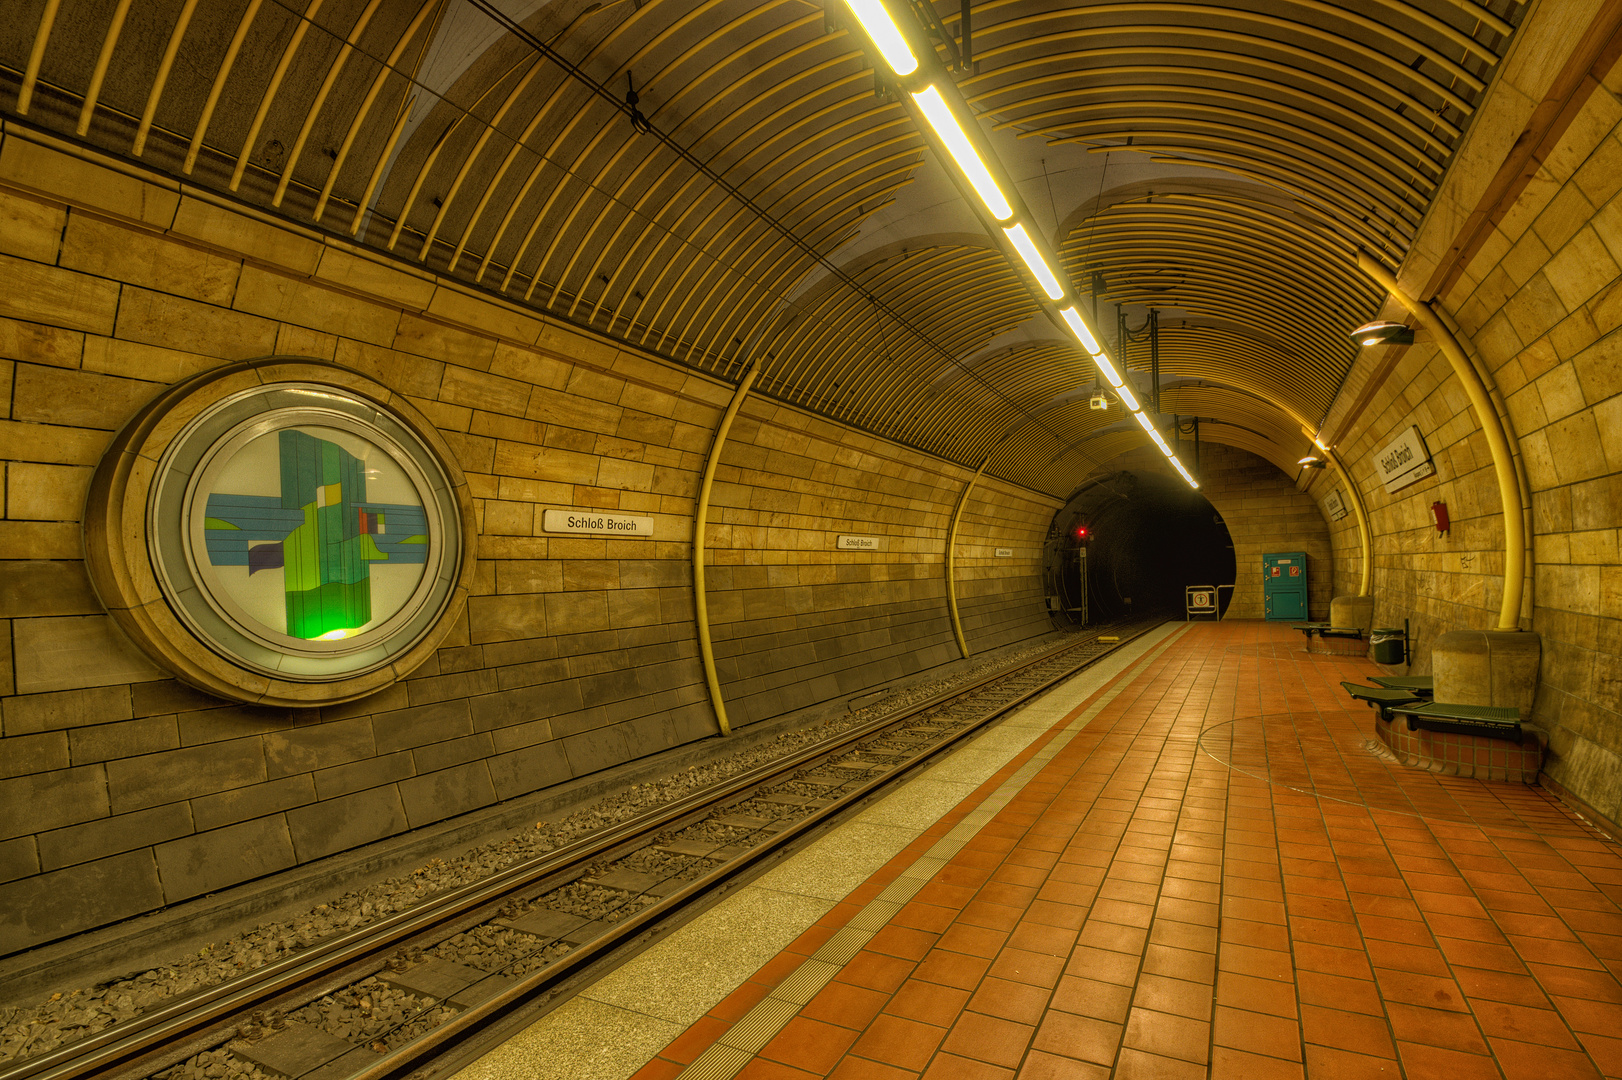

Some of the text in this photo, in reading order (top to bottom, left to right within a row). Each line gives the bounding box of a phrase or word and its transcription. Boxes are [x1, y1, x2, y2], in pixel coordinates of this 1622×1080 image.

[1381, 452, 1399, 474] Schloß
[1394, 442, 1414, 465] Broich
[567, 516, 637, 531] Schloß Broich
